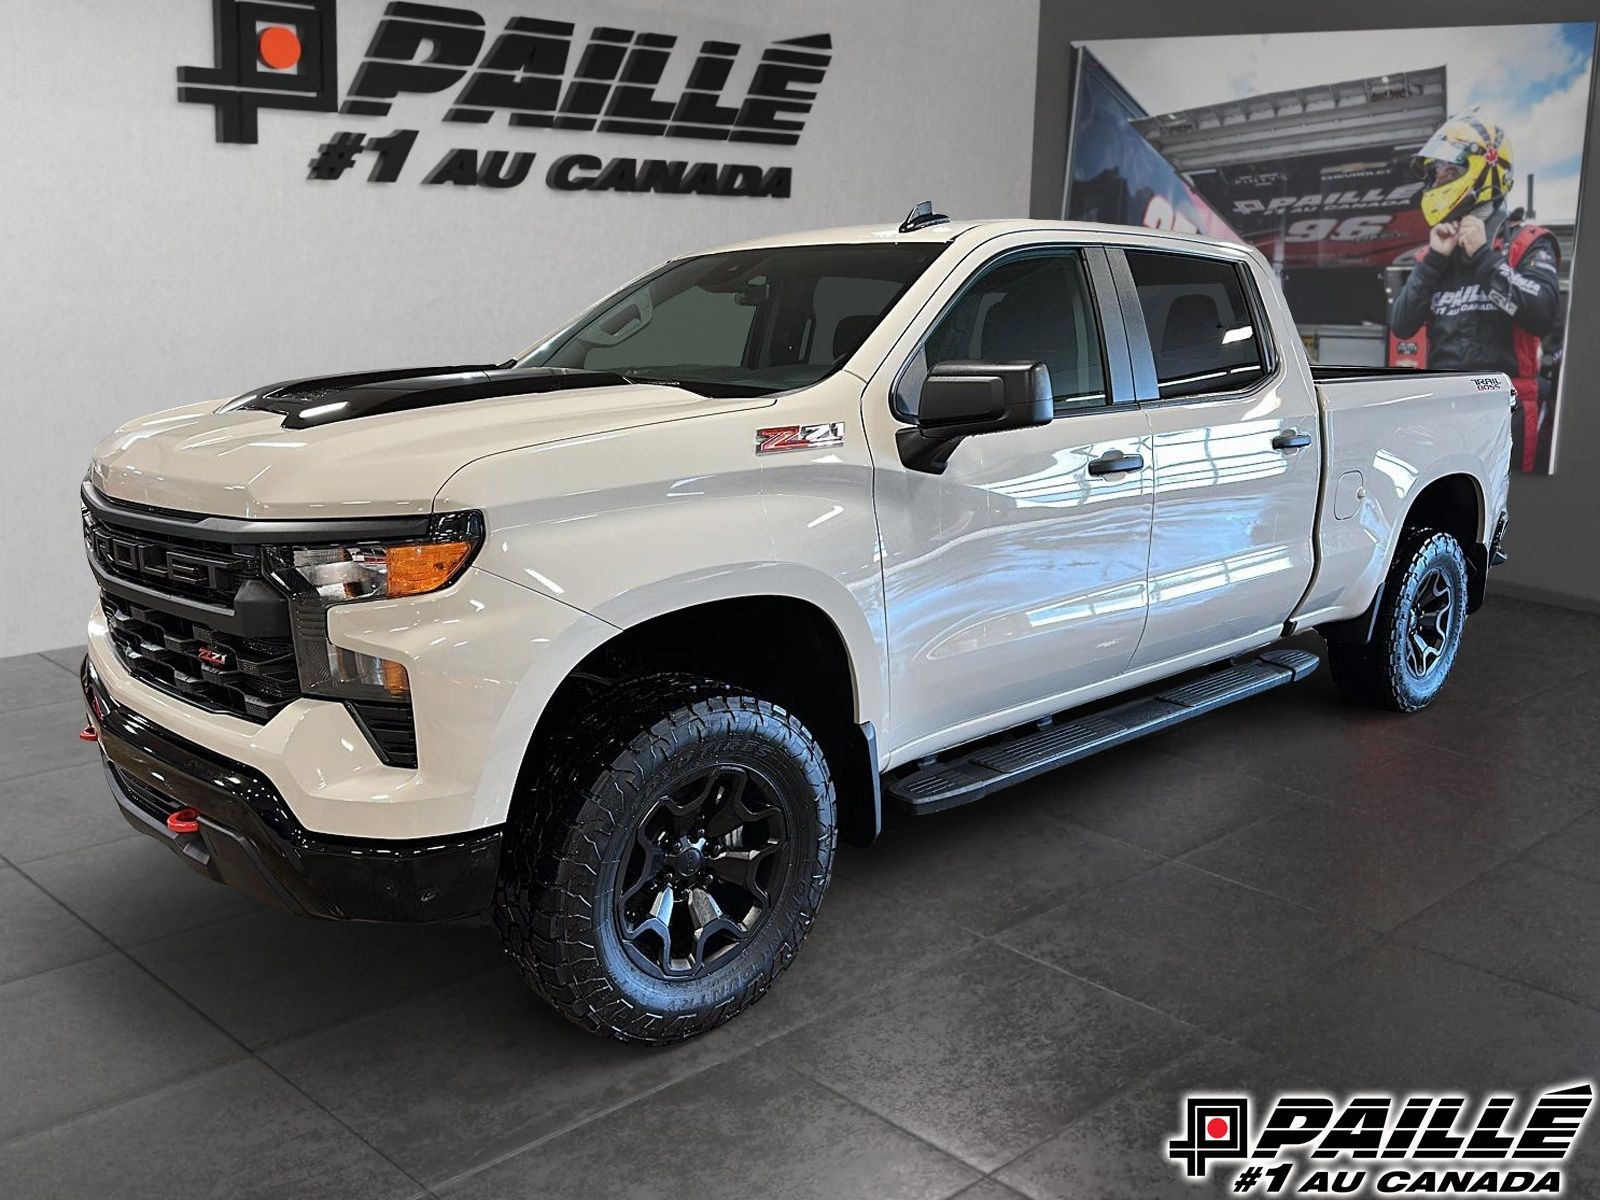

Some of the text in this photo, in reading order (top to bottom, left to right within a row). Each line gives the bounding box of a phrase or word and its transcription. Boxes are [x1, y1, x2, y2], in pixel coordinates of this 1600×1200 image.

[338, 1, 832, 145] PAILLÉ
[306, 129, 792, 198] #1 AU CANADA
[1324, 199, 1411, 212] CANADA
[1286, 216, 1391, 242] 96
[1470, 378, 1502, 386] TRAIL
[1477, 384, 1501, 392] BOSS
[756, 422, 845, 455] Z71
